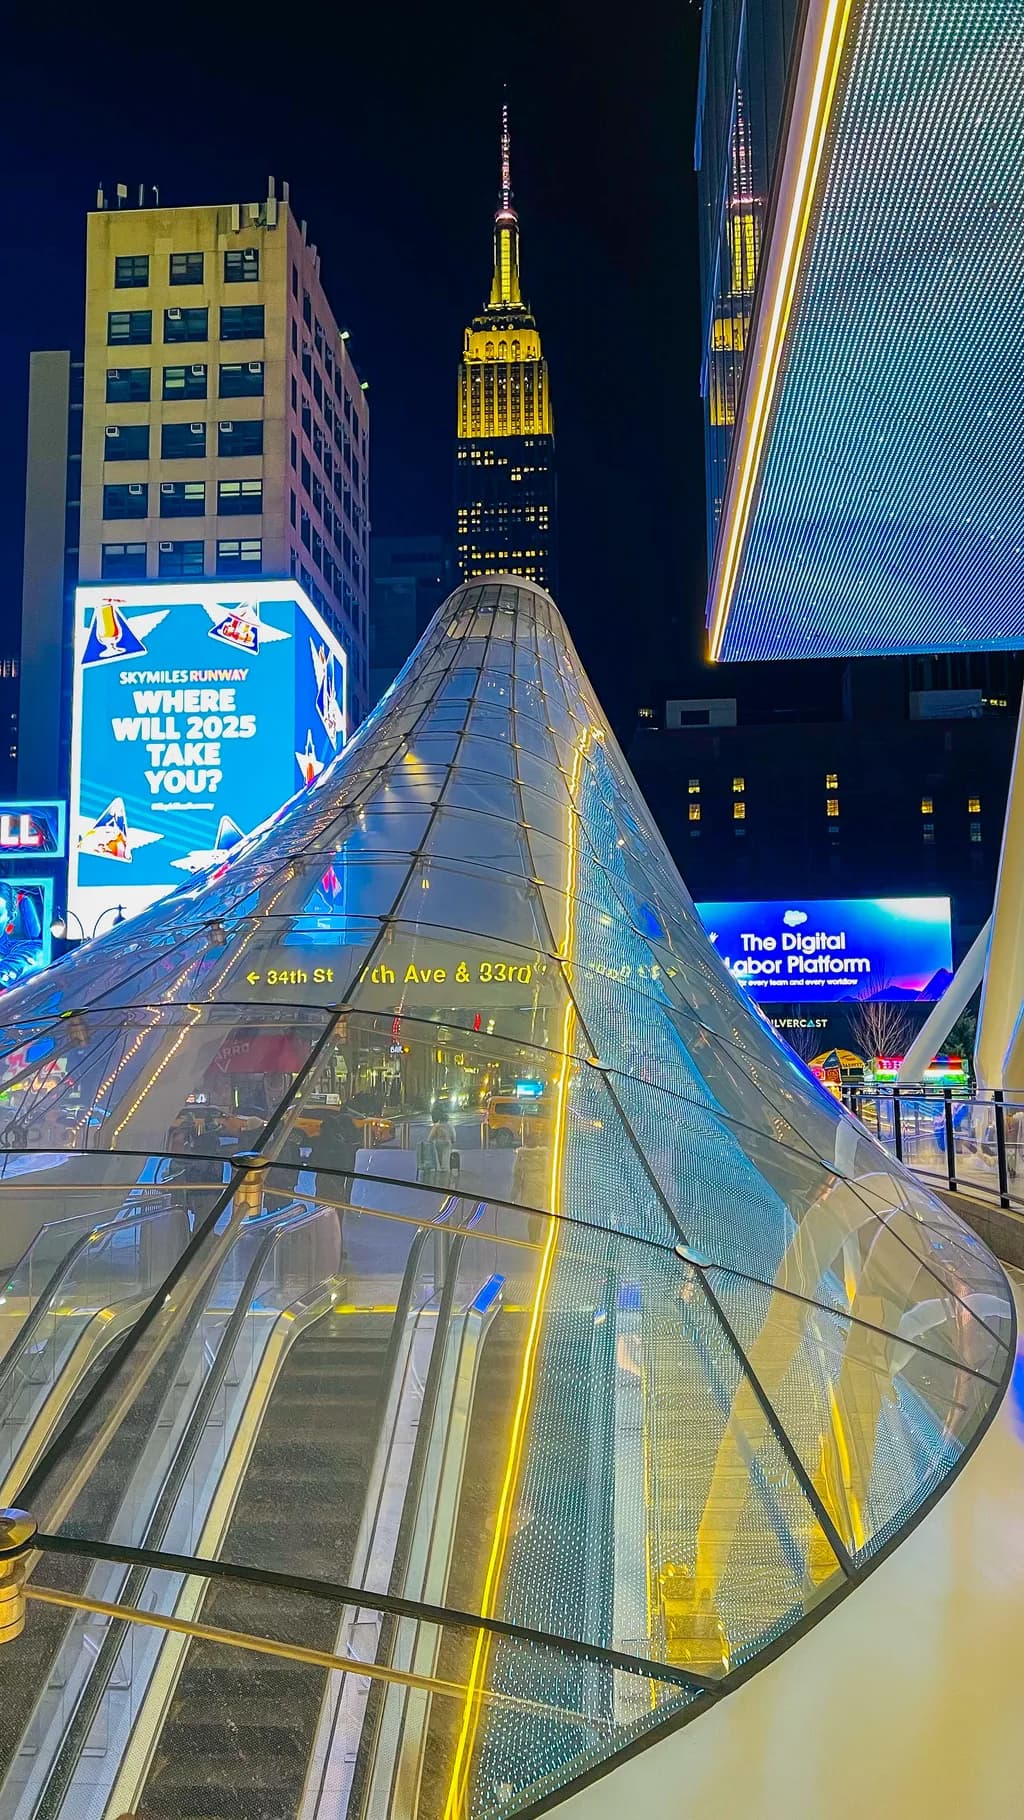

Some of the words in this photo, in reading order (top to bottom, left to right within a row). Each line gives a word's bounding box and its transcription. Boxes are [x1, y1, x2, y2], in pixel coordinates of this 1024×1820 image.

[119, 670, 188, 685] SKYMILES
[189, 668, 249, 682] RUNWAY
[133, 688, 236, 714] WHERE
[111, 717, 181, 741] WILL
[186, 715, 257, 740] 2025
[146, 742, 221, 767] TAKE
[144, 768, 223, 794] YOU?
[0, 814, 41, 846] LL
[740, 933, 777, 951] The
[781, 931, 846, 955] Digital
[404, 963, 447, 984] Ave
[455, 961, 470, 984] &
[479, 961, 532, 985] 33rd
[725, 956, 782, 974] Labor
[787, 954, 871, 974] Platform
[267, 970, 308, 985] 34th
[313, 968, 334, 983] St
[748, 978, 768, 988] every
[769, 978, 788, 987] team
[789, 978, 804, 987] and
[805, 978, 826, 988] every
[770, 1018, 829, 1029] ILVERCAST
